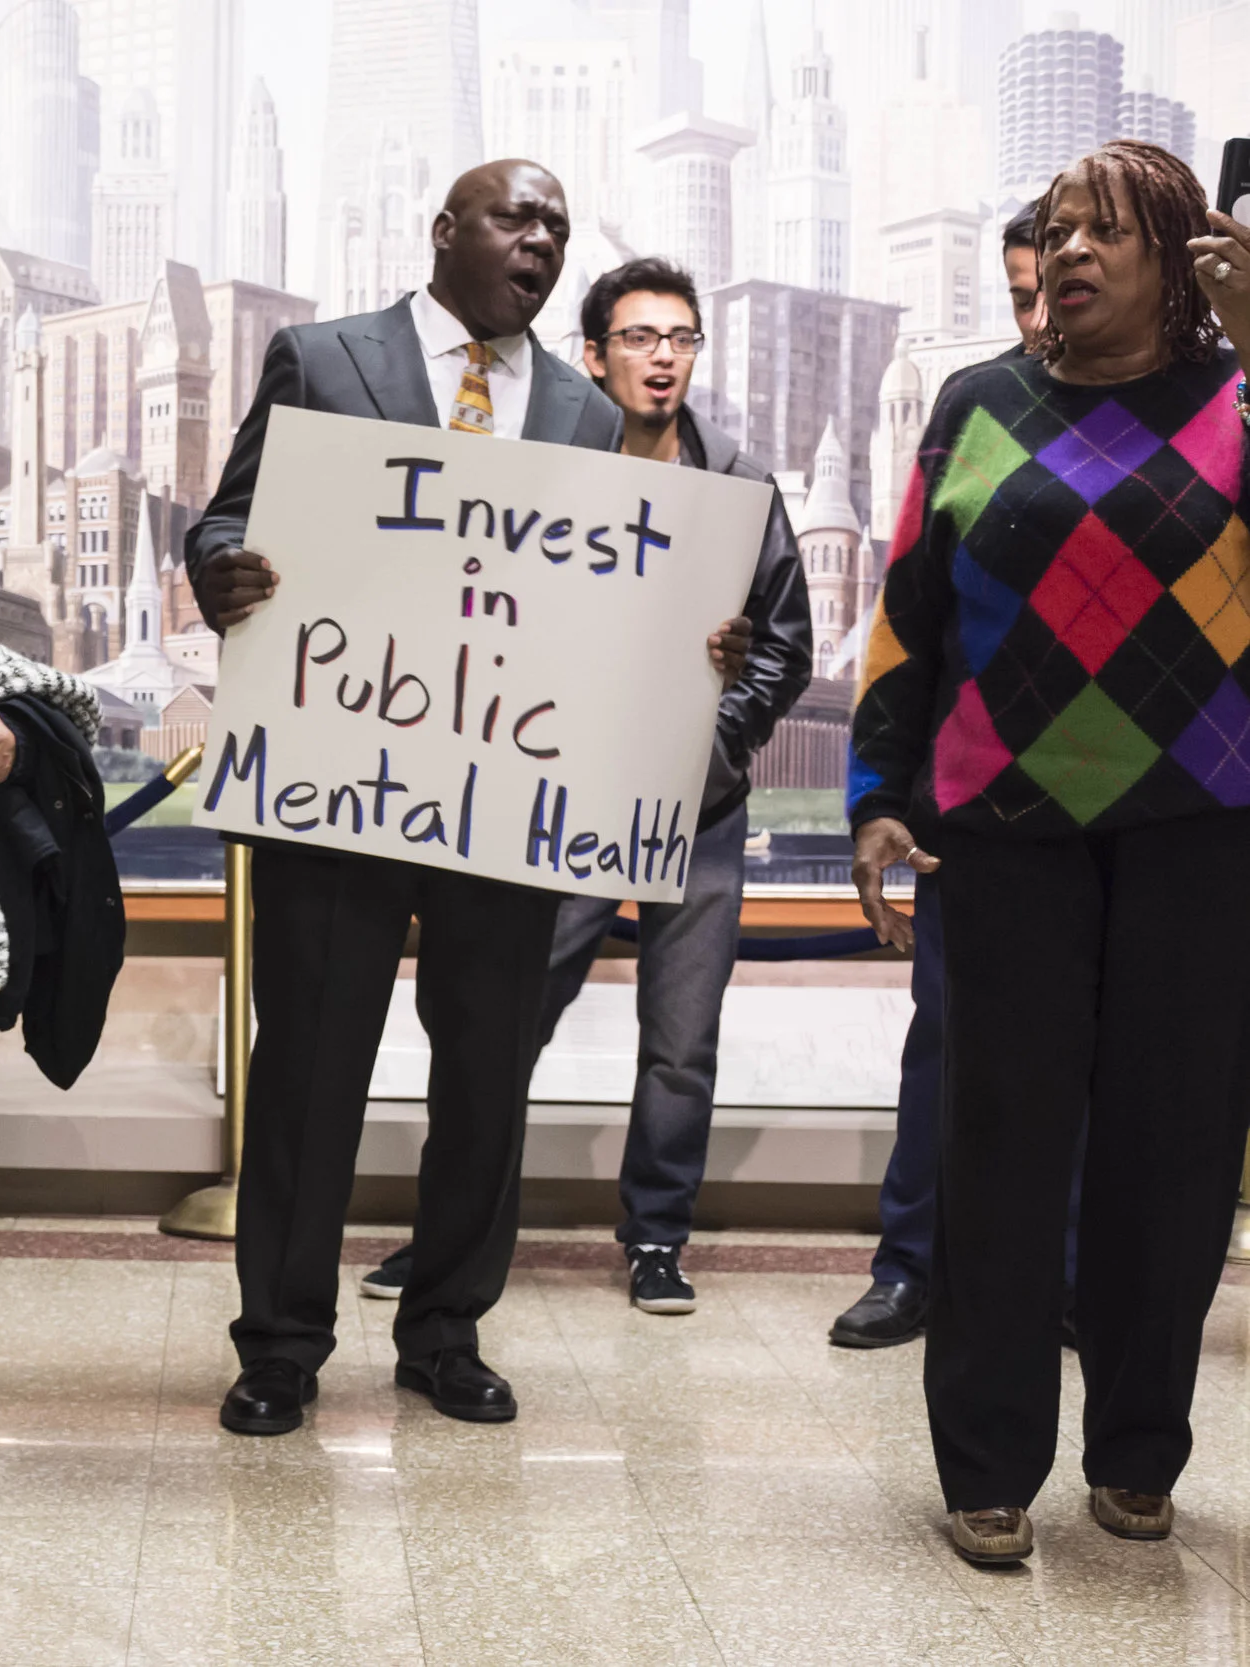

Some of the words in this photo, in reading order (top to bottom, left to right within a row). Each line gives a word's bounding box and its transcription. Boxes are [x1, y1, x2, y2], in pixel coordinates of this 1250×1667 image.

[375, 456, 672, 578] Invest
[461, 556, 518, 627] in
[293, 617, 561, 760] Public
[203, 724, 478, 859] Mental
[525, 777, 689, 890] Health
